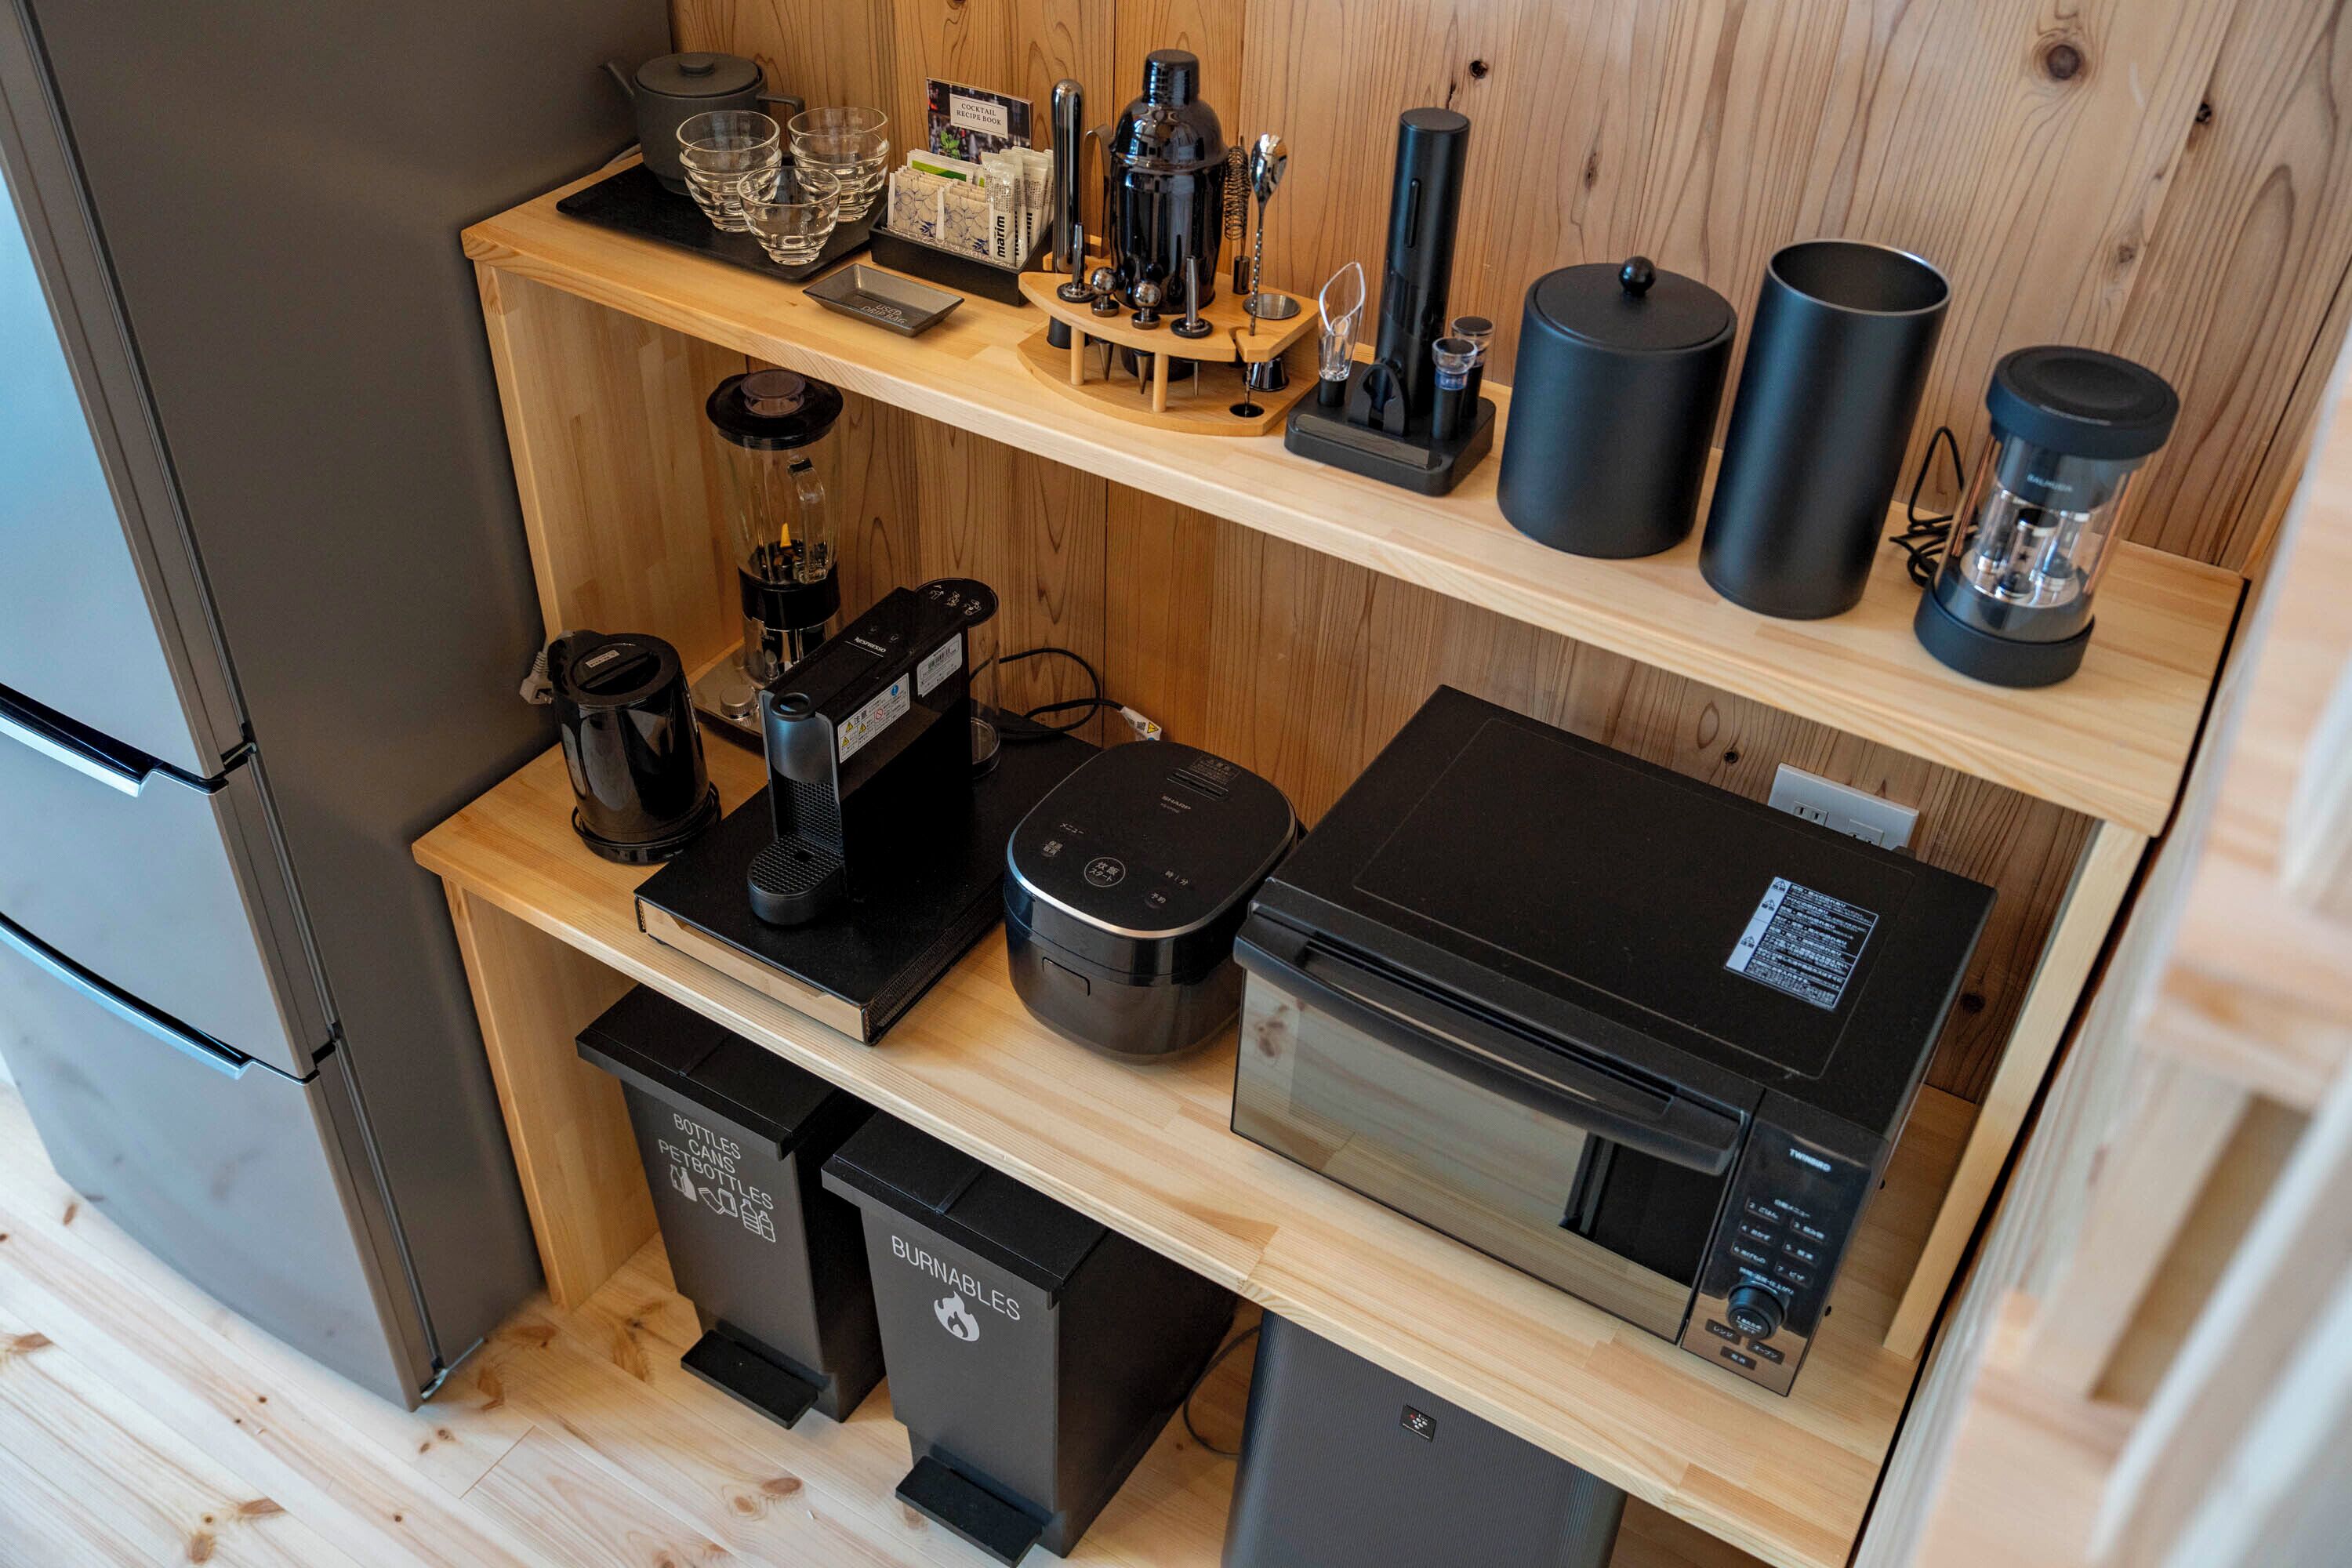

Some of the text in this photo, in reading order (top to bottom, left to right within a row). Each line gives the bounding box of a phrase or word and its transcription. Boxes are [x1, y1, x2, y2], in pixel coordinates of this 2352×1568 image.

[961, 103, 996, 116] COCKTAIL
[956, 110, 1002, 125] RECIPE BOOK
[995, 216, 1006, 258] marim
[876, 304, 902, 315] USED
[884, 312, 907, 324] BAG
[854, 636, 887, 653] NESPRESSO
[1161, 796, 1192, 810] SHARP
[1060, 823, 1084, 834] メニュー
[1088, 868, 1114, 882] スタート
[1095, 862, 1120, 876] 炊飯
[673, 1113, 741, 1160] BOTTLES
[688, 1139, 735, 1174] CANS
[1789, 1148, 1831, 1173] TWINBIRD
[658, 1138, 774, 1210] PETBOTTLES
[891, 1235, 1021, 1320] BURNABLES
